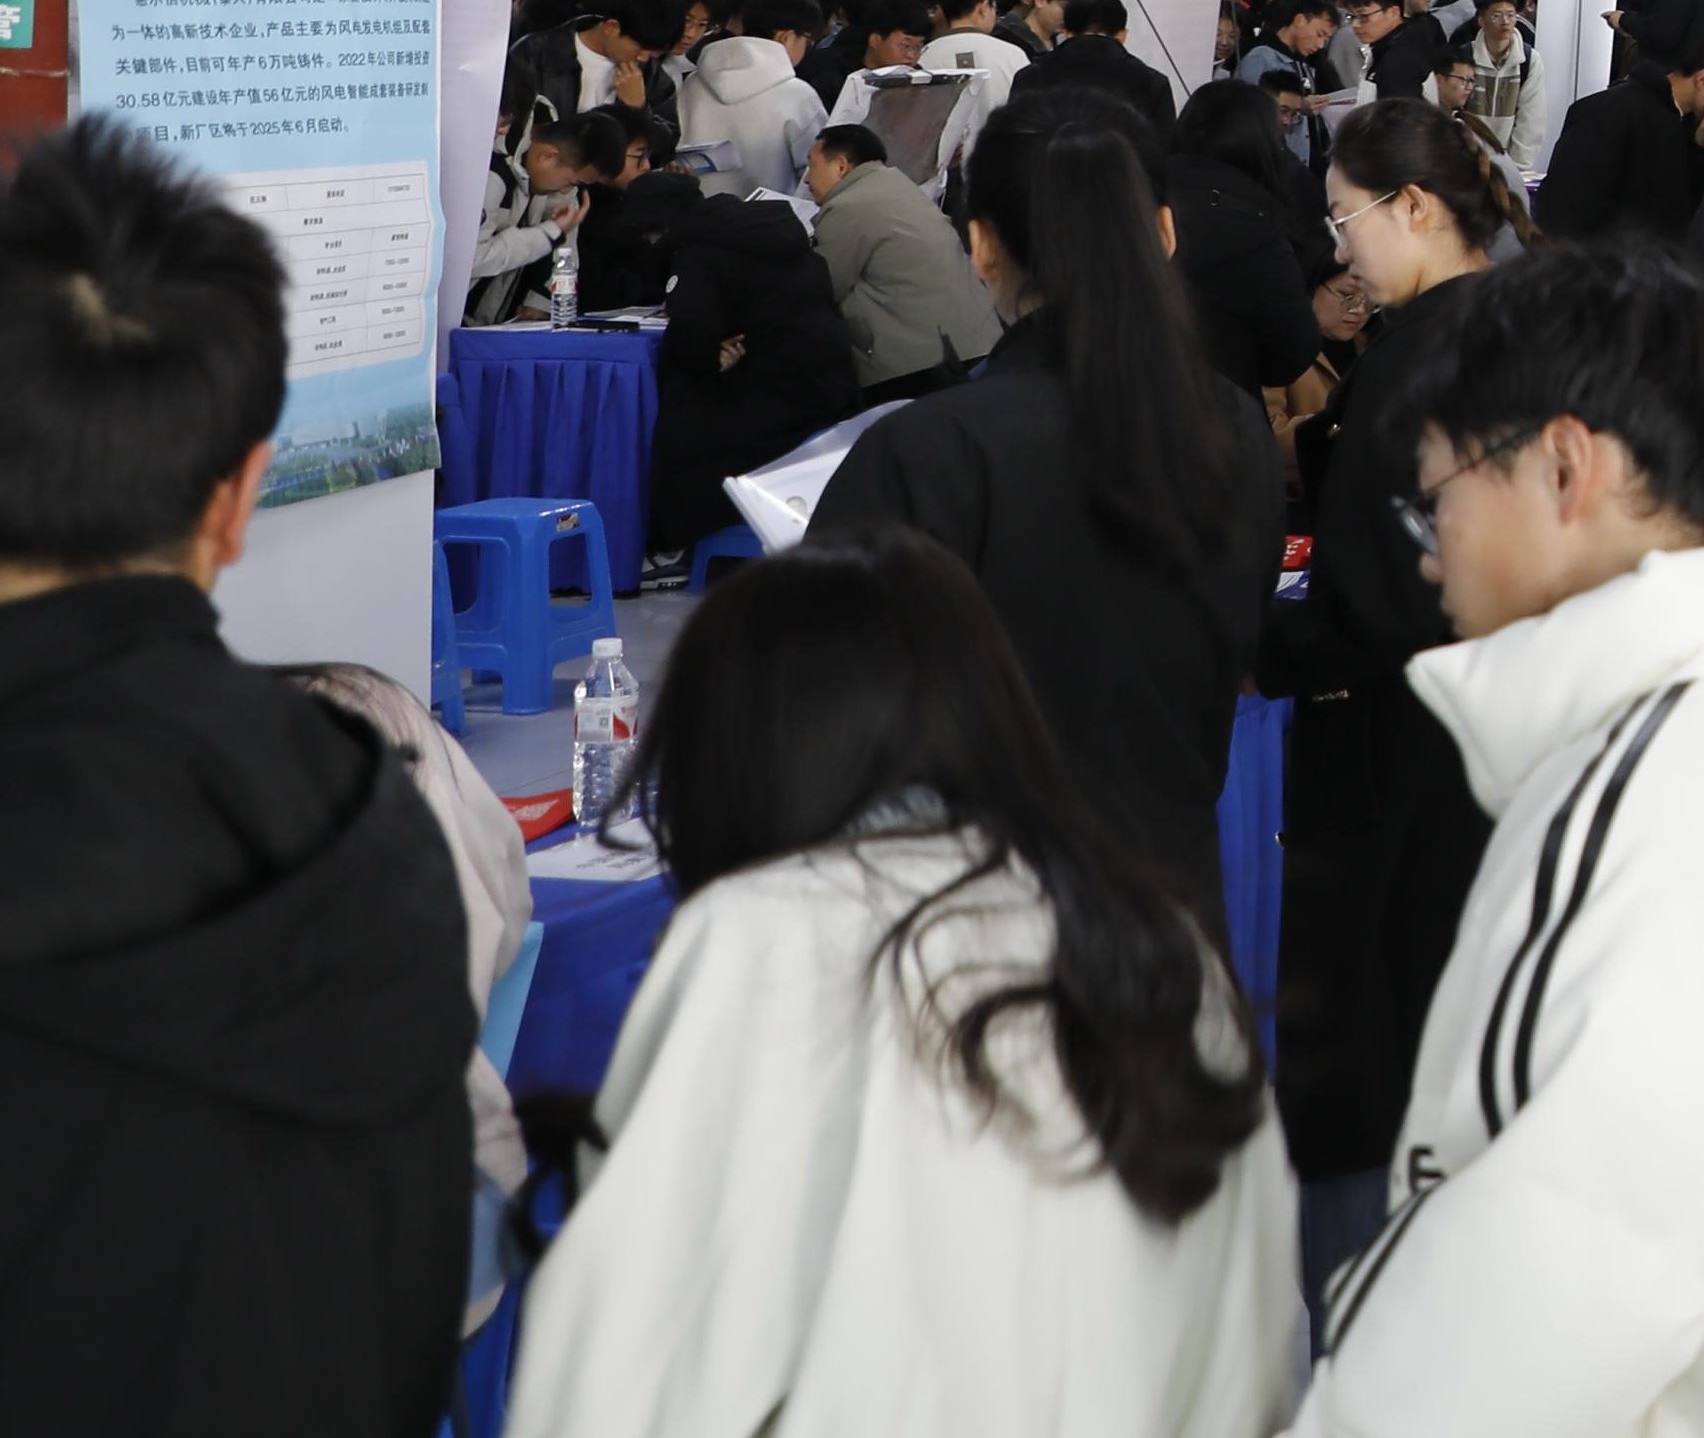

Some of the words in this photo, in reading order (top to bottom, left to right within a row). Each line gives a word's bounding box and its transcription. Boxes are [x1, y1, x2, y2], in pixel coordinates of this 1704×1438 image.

[124, 116, 350, 142] 项目，新厂区将于2025年6月启动。
